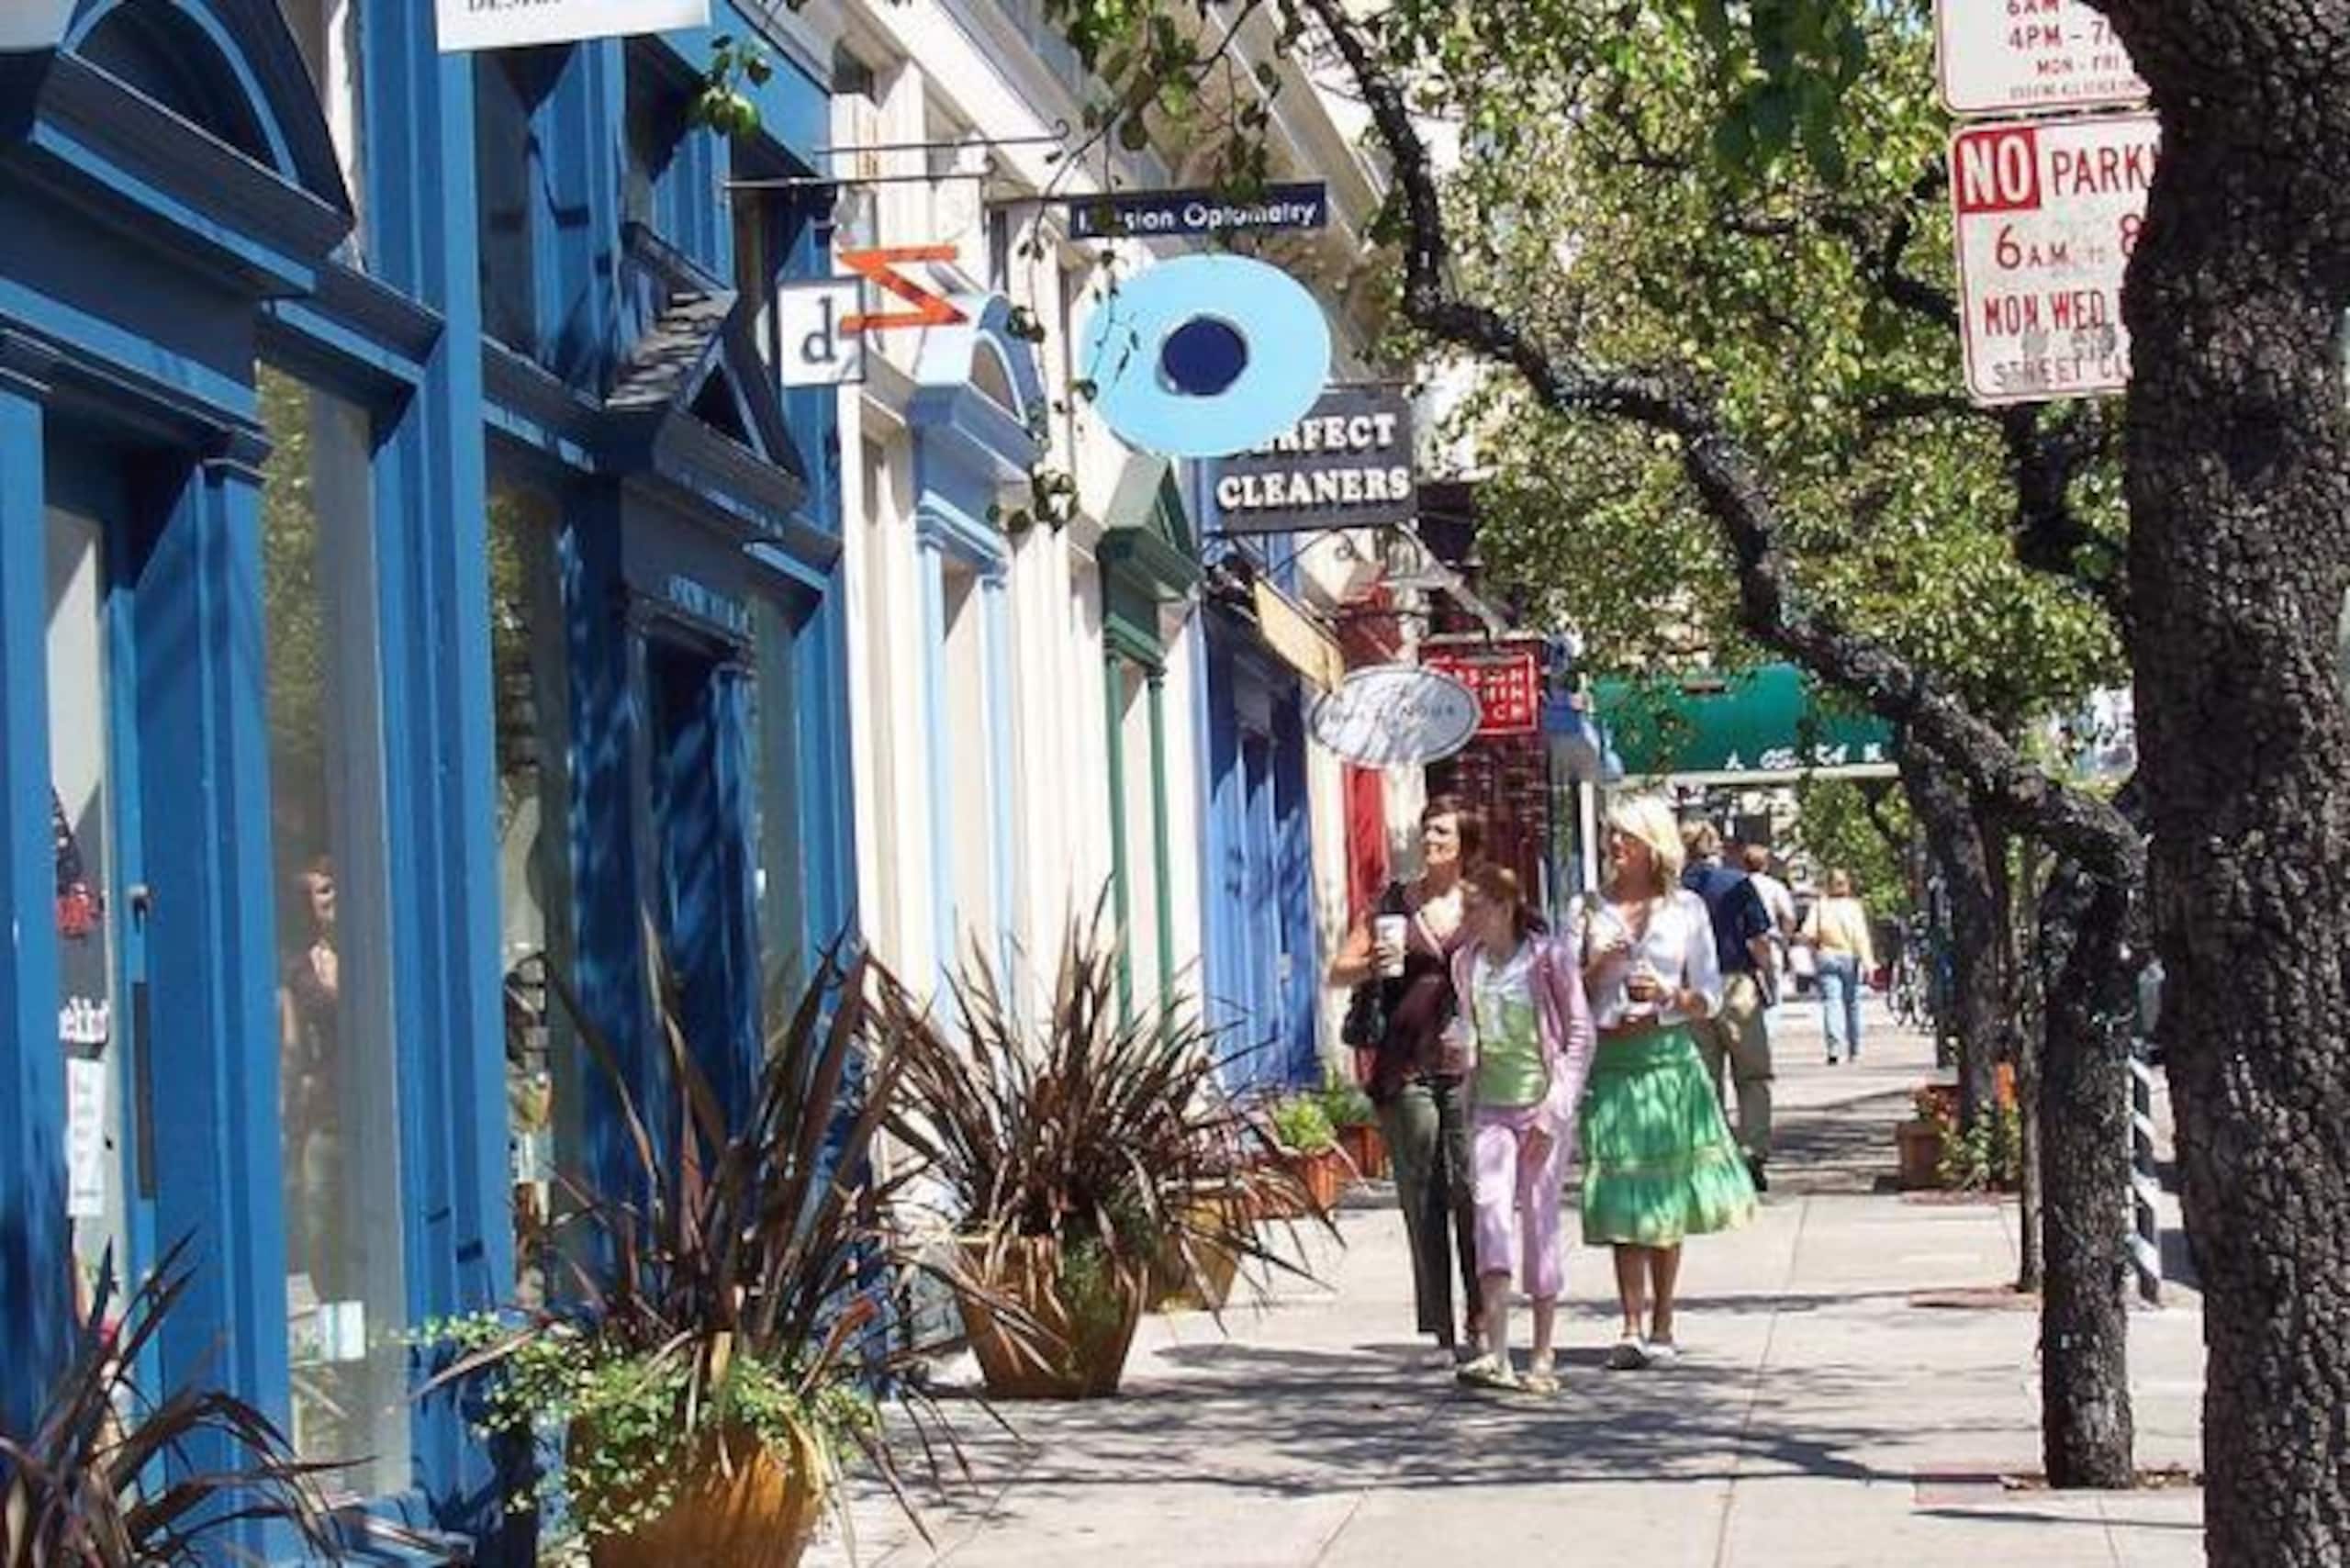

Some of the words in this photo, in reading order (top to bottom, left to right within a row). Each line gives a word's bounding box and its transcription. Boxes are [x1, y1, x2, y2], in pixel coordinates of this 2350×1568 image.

[2009, 24, 2063, 49] 4PM
[1960, 135, 2031, 207] NO
[800, 295, 838, 364] d
[1254, 413, 1397, 452] RFECT
[1216, 466, 1412, 509] CLEANERS
